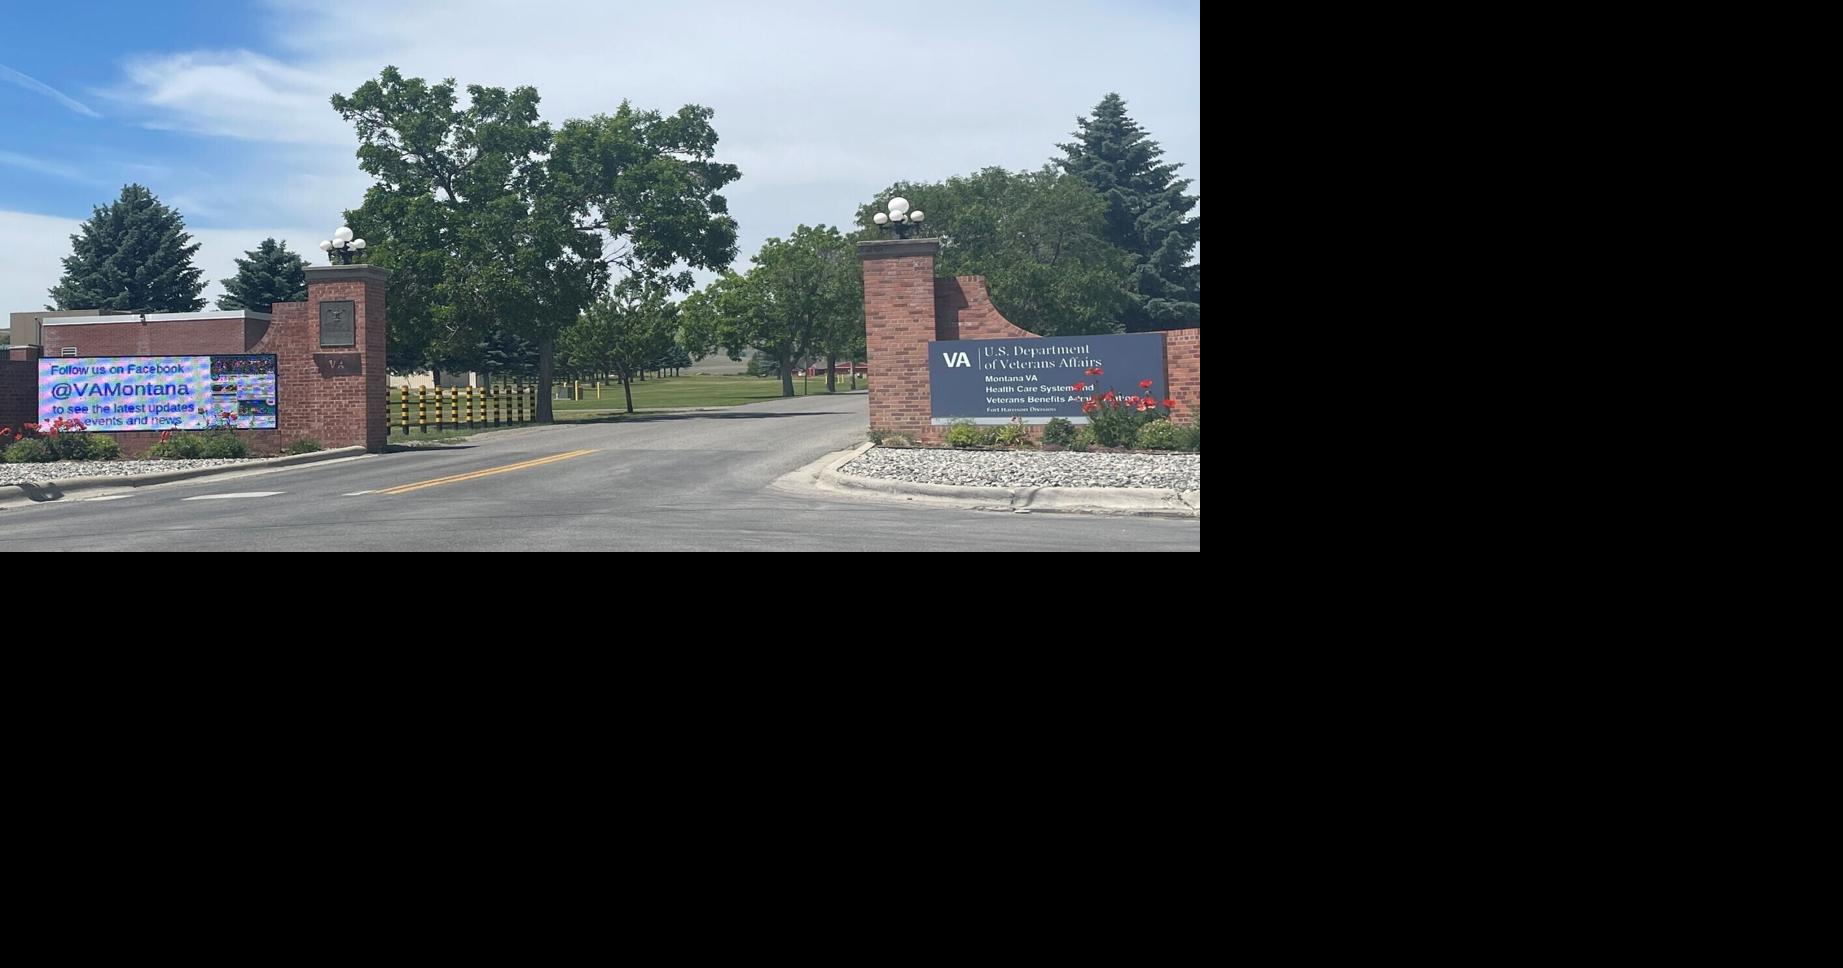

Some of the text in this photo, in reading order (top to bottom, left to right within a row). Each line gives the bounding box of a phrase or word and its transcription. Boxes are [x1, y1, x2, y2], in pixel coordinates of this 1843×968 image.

[984, 344, 1090, 358] U.S. Department
[328, 360, 344, 368] VA
[943, 352, 971, 367] VA
[984, 358, 1102, 370] of Veterans Affairs
[50, 365, 90, 375] Follow
[110, 366, 124, 374] on
[128, 363, 184, 374] Facebook
[52, 382, 189, 400] @VAMontana
[986, 385, 1014, 393] Health
[1040, 384, 1074, 393] System
[1027, 394, 1065, 403] Benefits
[53, 403, 194, 415] to see the latest updates
[85, 416, 122, 426] events
[126, 415, 148, 425] and
[152, 416, 182, 425] news
